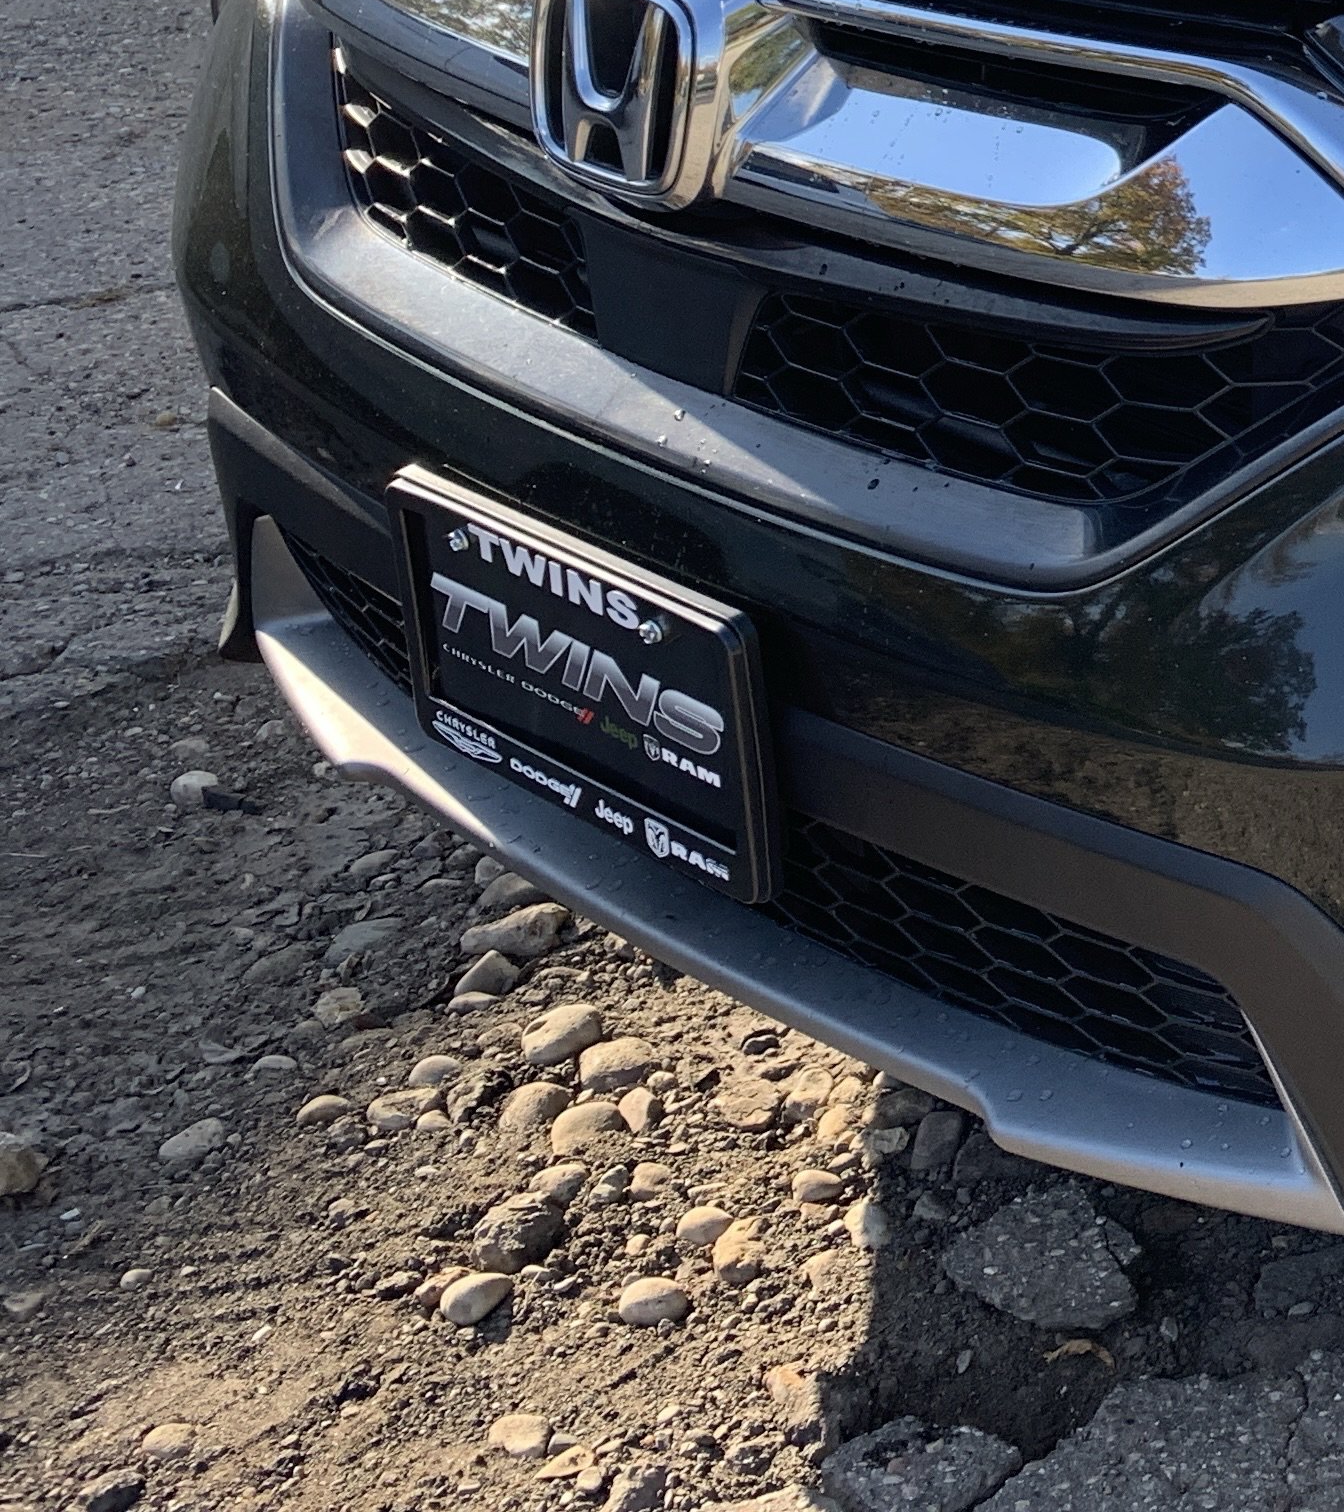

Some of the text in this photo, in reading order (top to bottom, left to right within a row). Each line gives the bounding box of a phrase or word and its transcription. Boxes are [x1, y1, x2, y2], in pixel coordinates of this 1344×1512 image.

[467, 523, 641, 630] TWINS
[430, 572, 724, 756] TWINS
[443, 643, 515, 684] CHRYSLER
[601, 714, 638, 750] Jeep
[661, 747, 721, 788] RAM
[436, 710, 730, 881] CHRYSLER DODGE Jeep RAM
